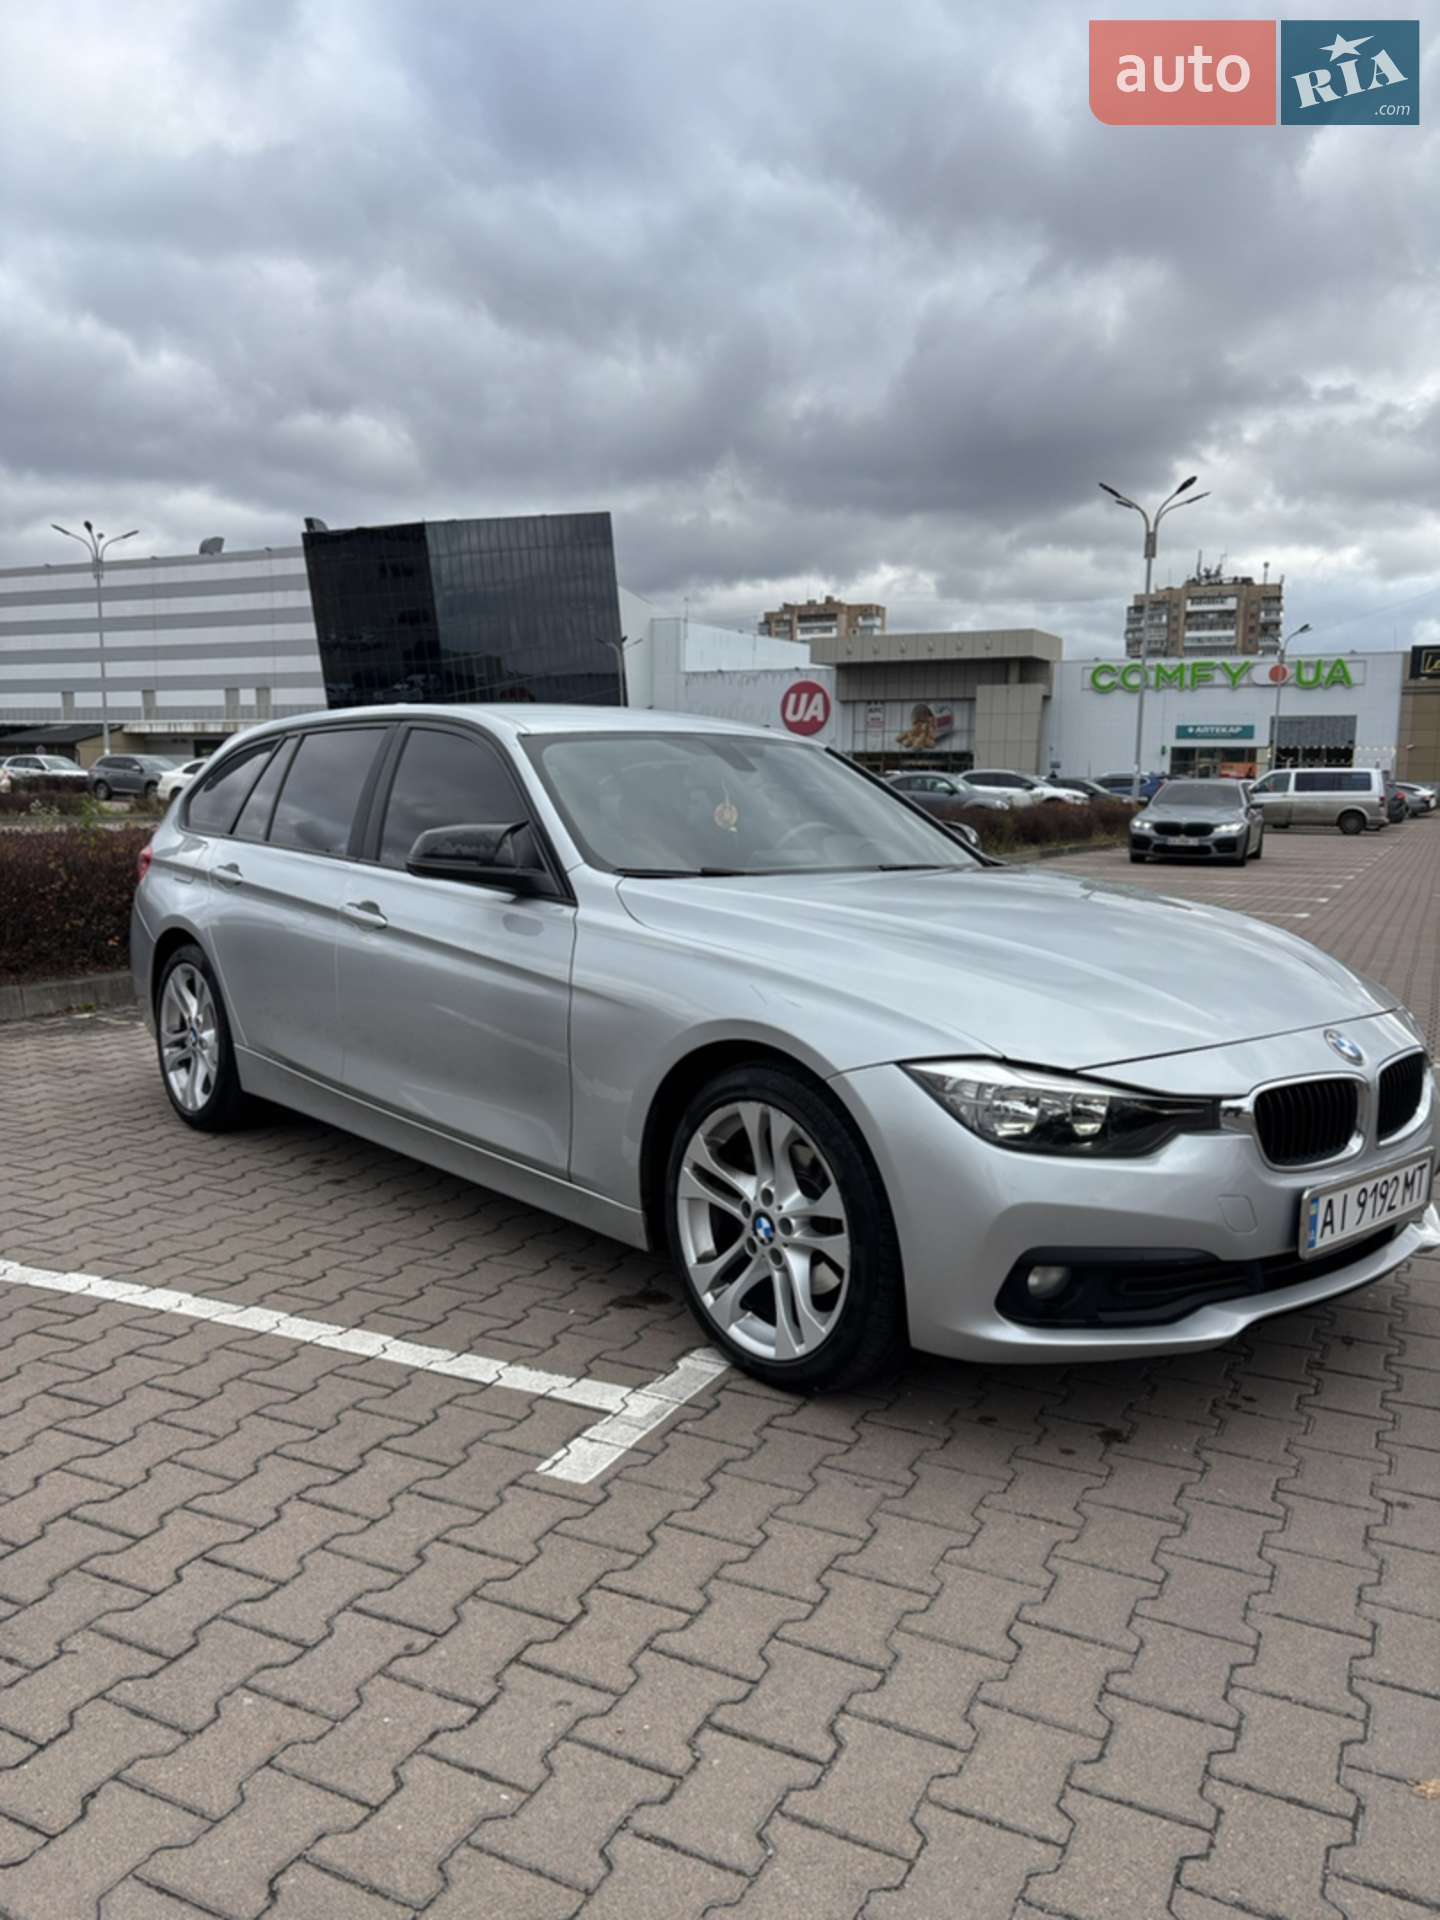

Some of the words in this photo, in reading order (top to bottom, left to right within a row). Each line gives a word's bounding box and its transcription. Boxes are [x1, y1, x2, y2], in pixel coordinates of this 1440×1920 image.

[1090, 660, 1251, 692] COMFY
[1296, 657, 1353, 688] UA
[785, 692, 826, 723] UA
[1320, 1193, 1348, 1240] AI
[1355, 1175, 1400, 1226] 9192
[1401, 1162, 1428, 1206] MT
